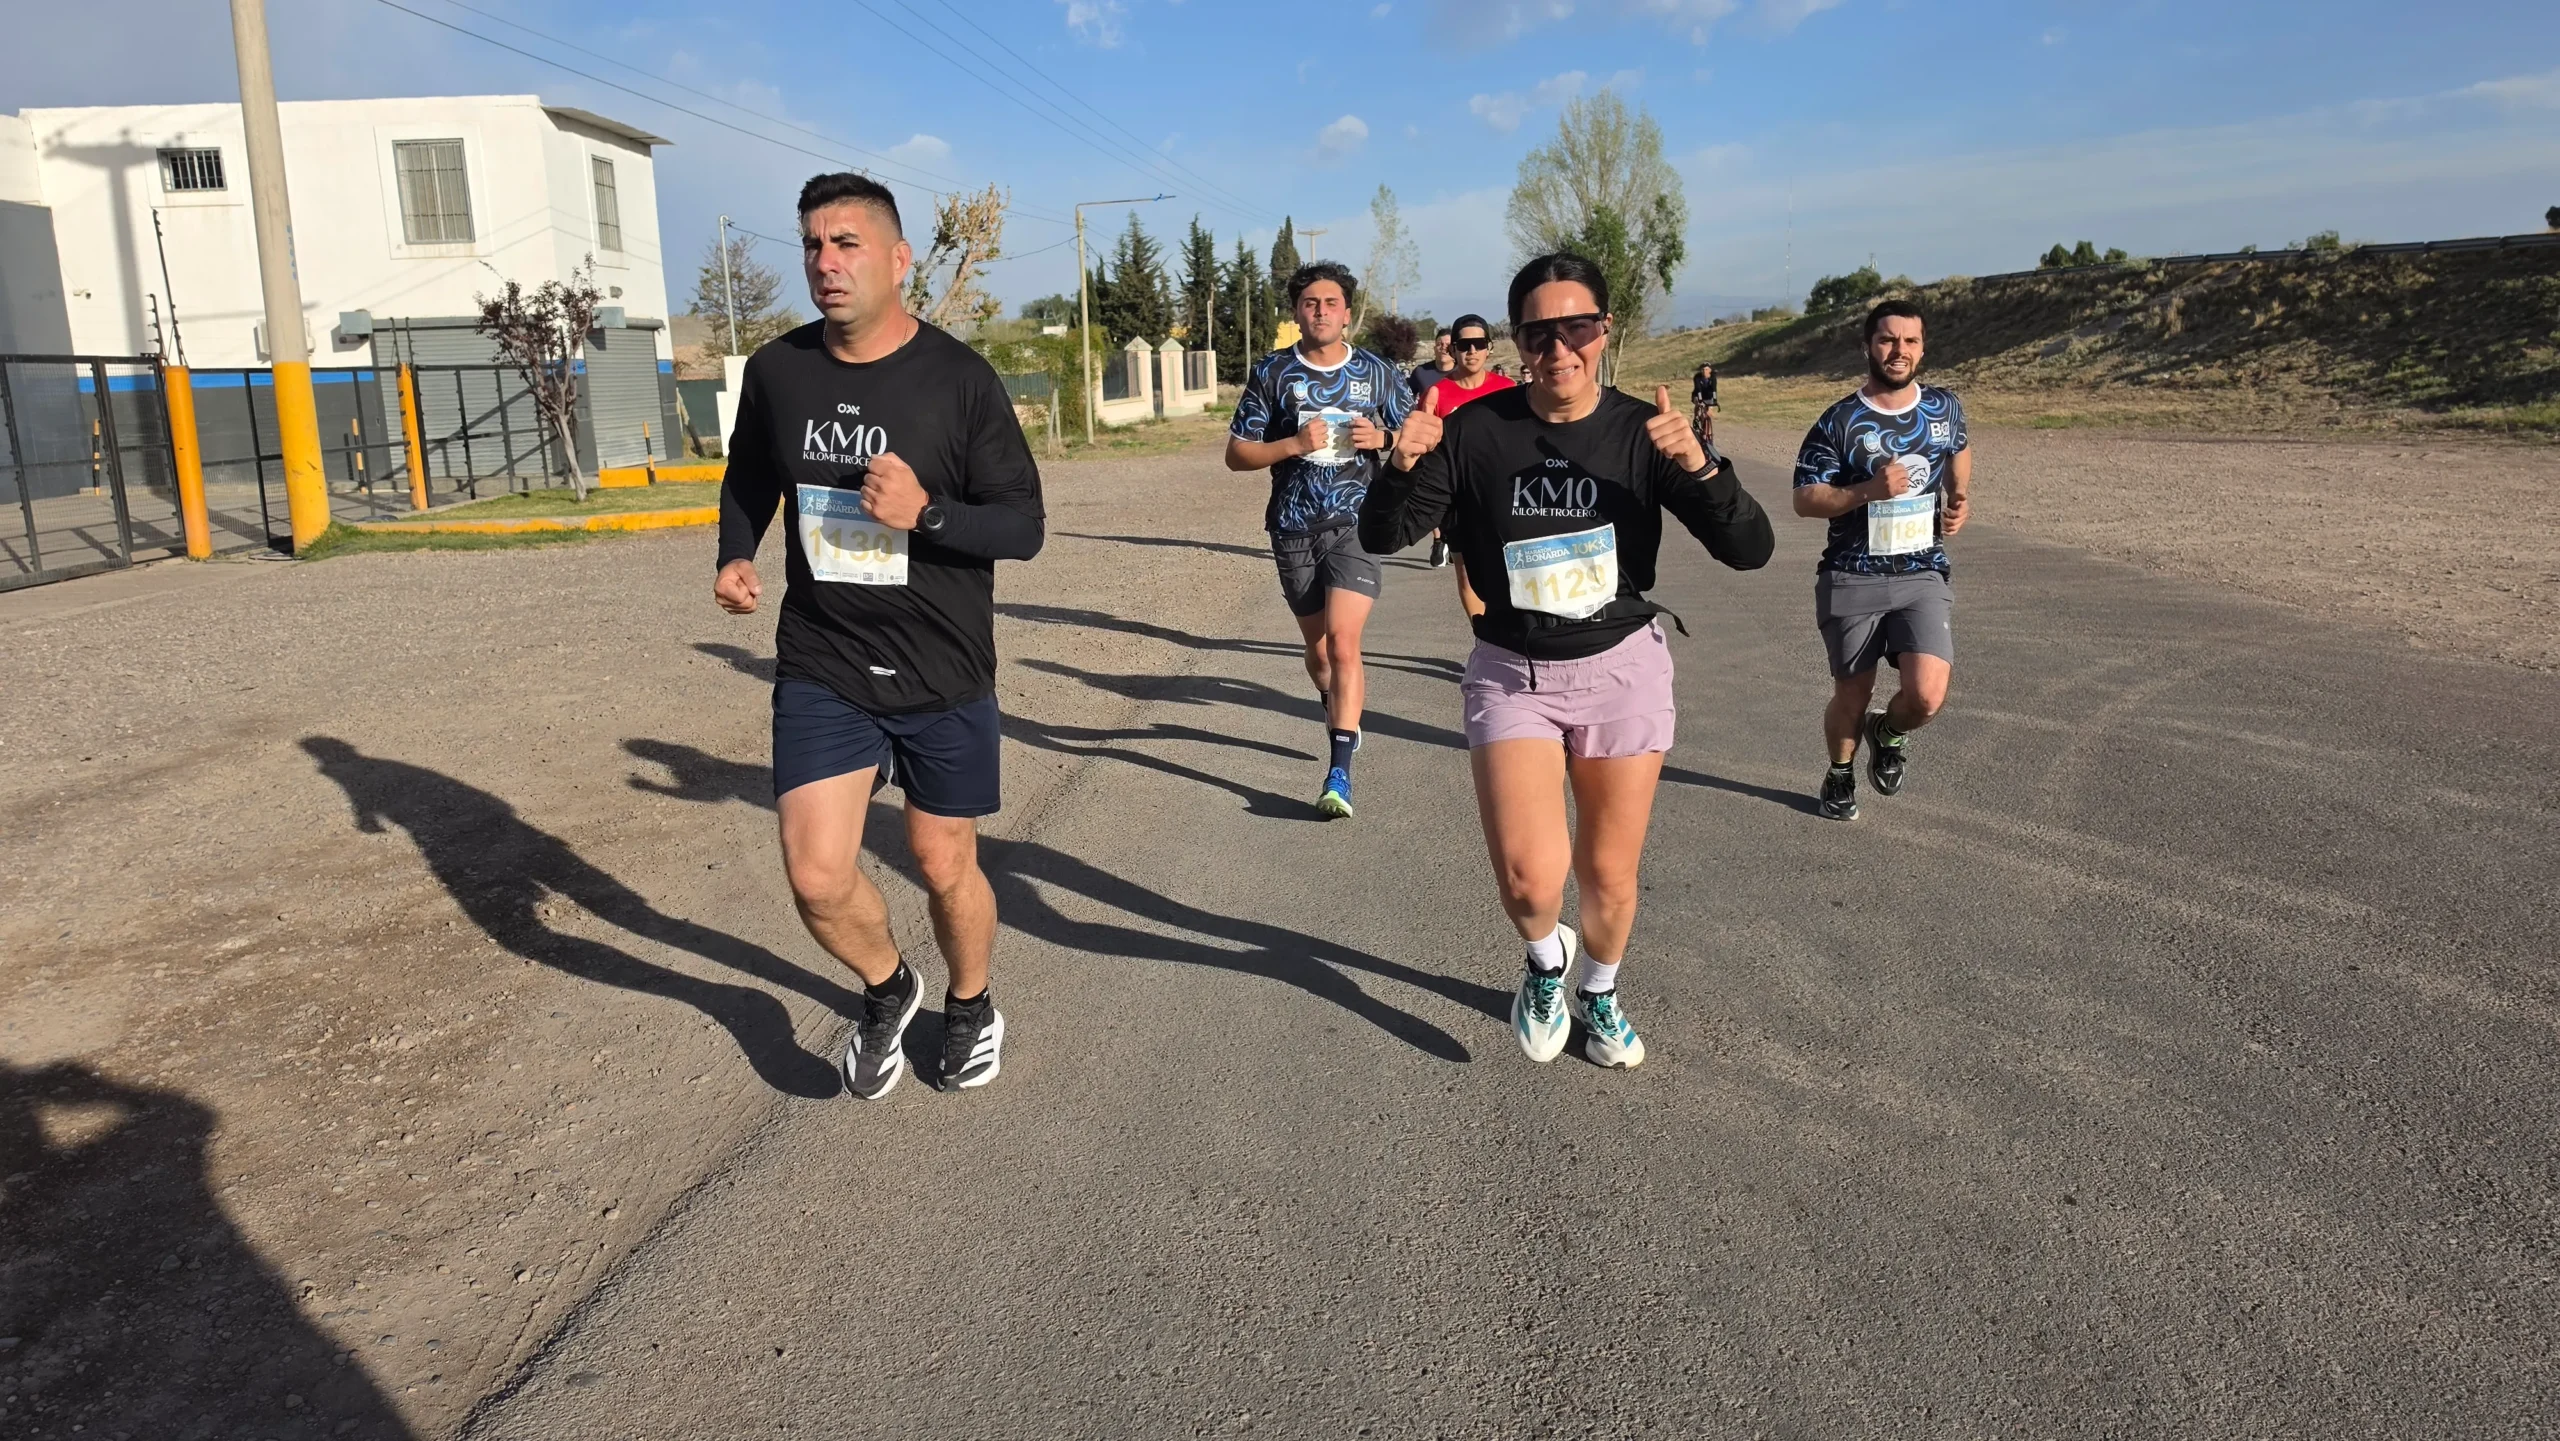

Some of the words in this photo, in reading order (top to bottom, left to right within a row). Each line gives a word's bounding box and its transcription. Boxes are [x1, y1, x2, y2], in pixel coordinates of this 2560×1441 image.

[802, 450, 870, 467] KILOMETROCE
[815, 502, 861, 515] BONARDA
[1511, 507, 1597, 518] KILOMETROCERO
[1879, 518, 1928, 542] 1184
[808, 525, 893, 563] 1130
[1525, 548, 1570, 563] BONARDA
[1572, 542, 1599, 555] 10K
[1524, 564, 1607, 606] 1129
